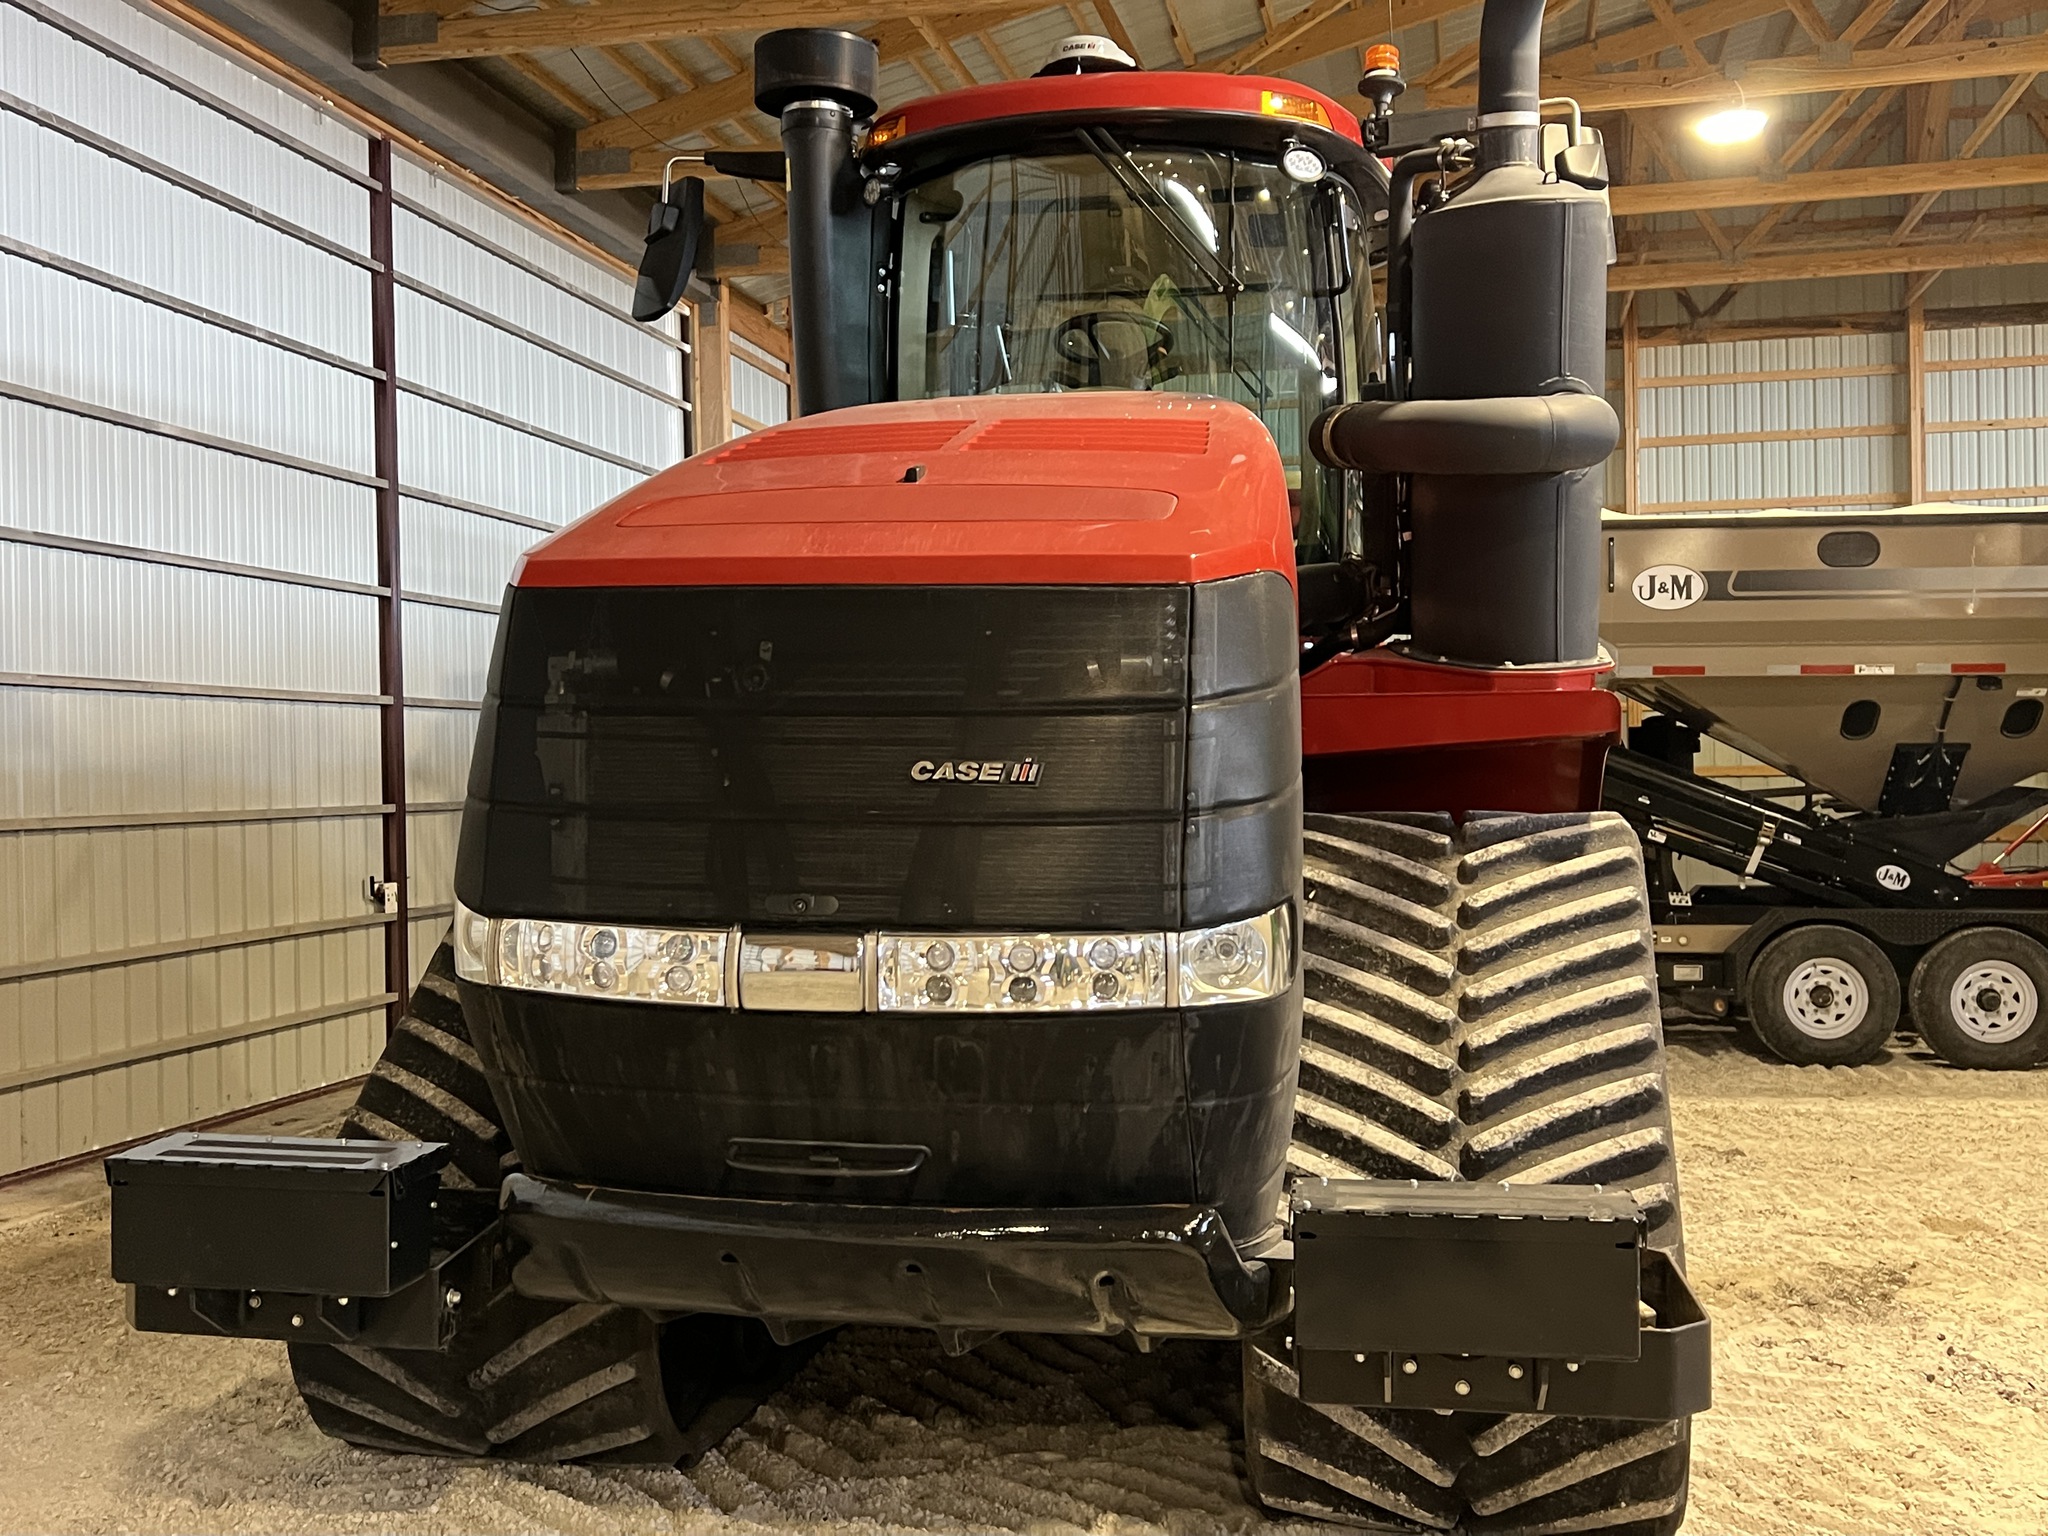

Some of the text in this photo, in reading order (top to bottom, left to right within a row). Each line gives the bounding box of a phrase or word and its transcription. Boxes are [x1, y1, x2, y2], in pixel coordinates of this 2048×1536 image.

[1062, 43, 1087, 52] CASE
[1638, 574, 1694, 601] J&M
[910, 760, 1004, 782] CASE
[1878, 868, 1908, 888] J&M
